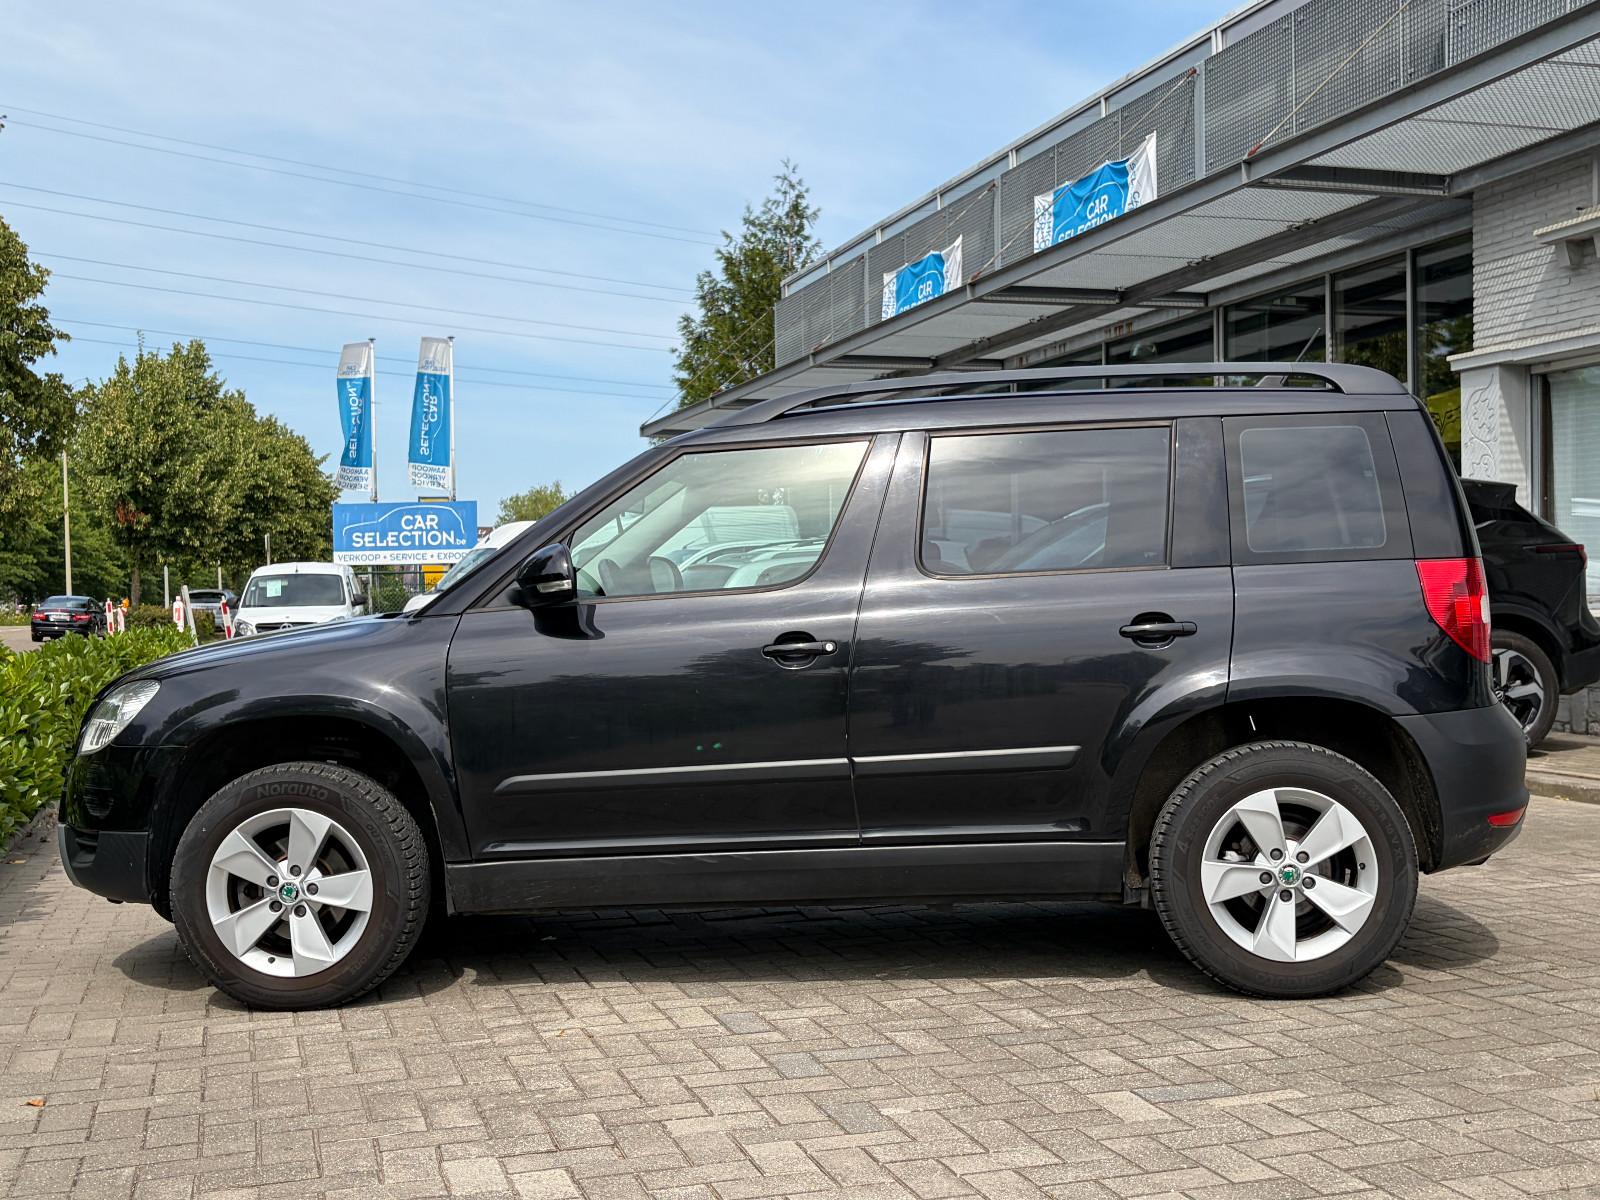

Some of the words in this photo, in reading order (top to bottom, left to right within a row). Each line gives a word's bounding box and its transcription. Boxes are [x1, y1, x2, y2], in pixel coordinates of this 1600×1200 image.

[1086, 194, 1108, 220] CAR
[401, 514, 439, 531] CAR
[338, 553, 381, 562] VERKOOP
[389, 552, 428, 561] SERVICE
[256, 782, 329, 800] Norauto
